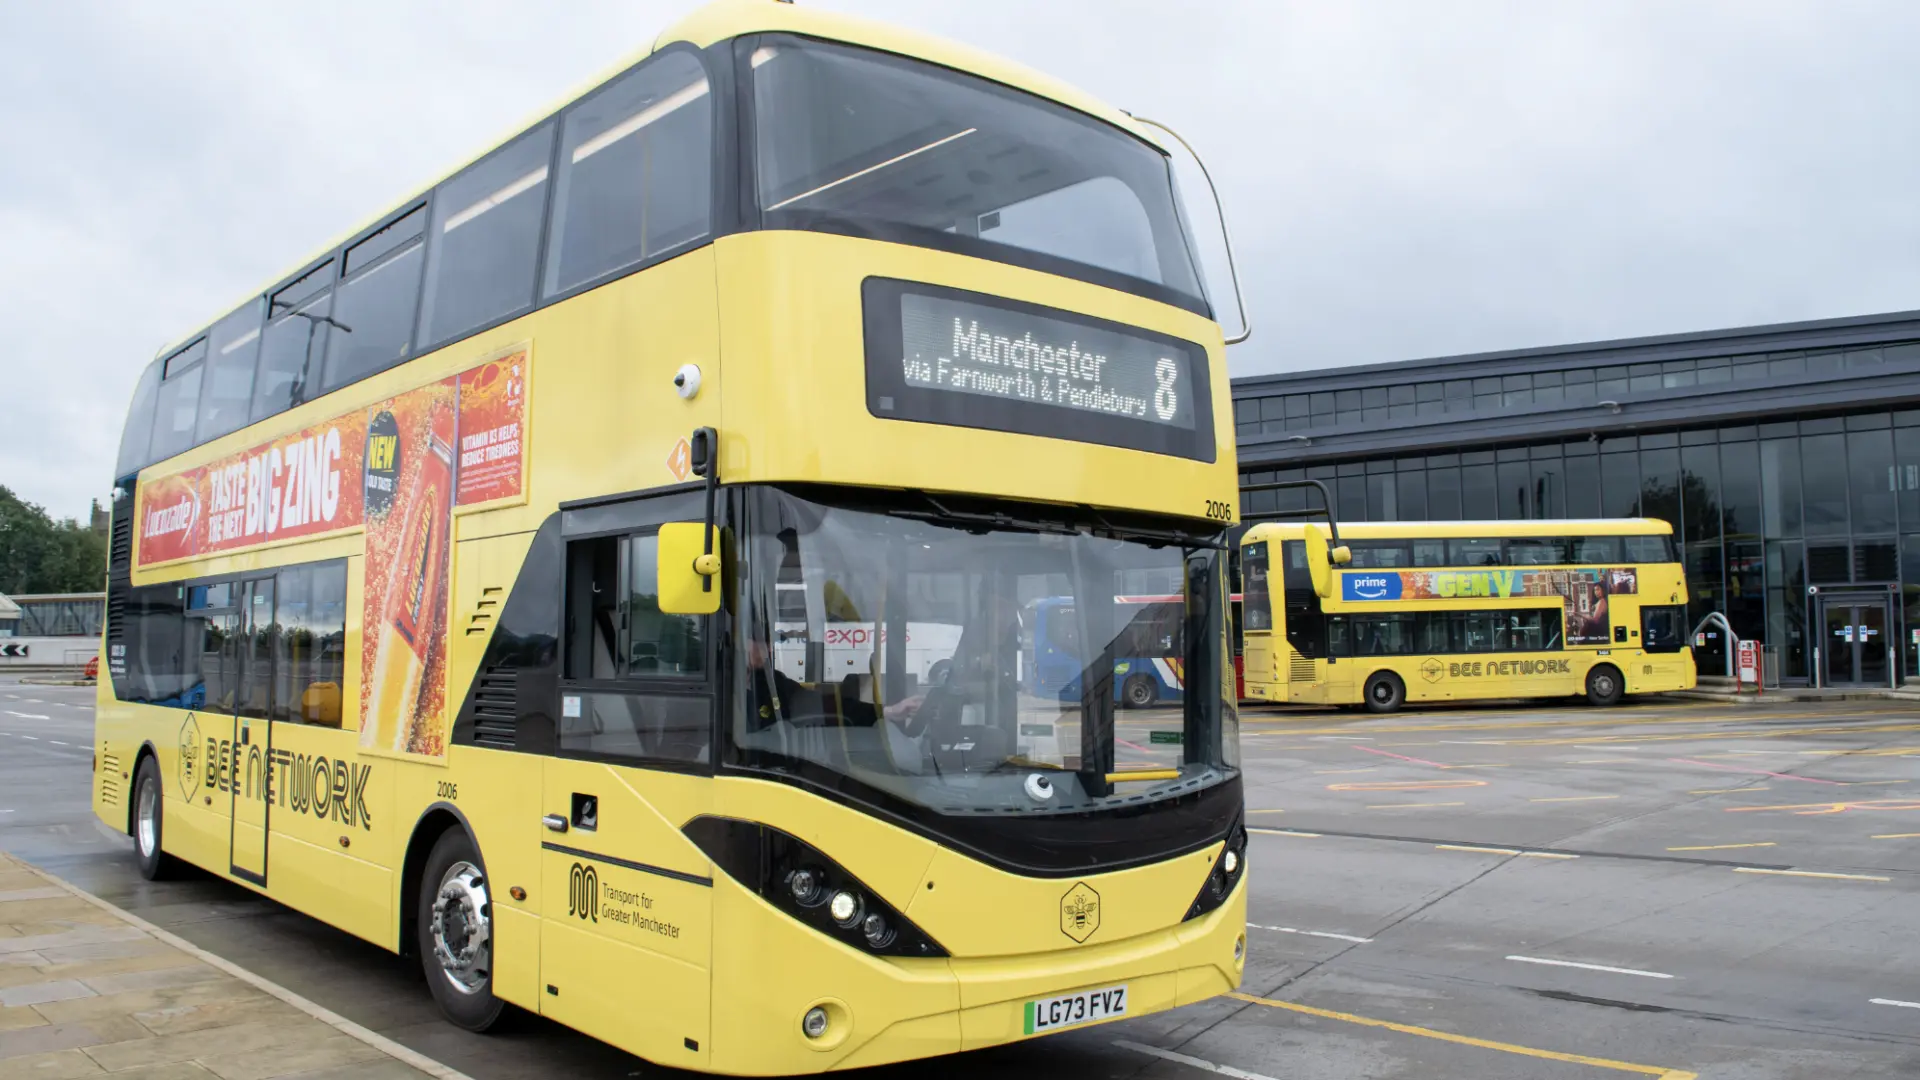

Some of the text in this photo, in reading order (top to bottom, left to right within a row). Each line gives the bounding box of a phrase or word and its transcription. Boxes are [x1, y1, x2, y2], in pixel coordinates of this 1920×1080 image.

[953, 317, 1107, 382] Manchester
[903, 353, 1147, 416] via Farnworth & Pendlebury
[1154, 357, 1177, 420] 8
[369, 434, 397, 469] NEW
[461, 439, 519, 468] REDUCE TIREDNESS
[462, 431, 488, 452] VITAMIN
[209, 461, 246, 514] TASTE
[245, 427, 341, 537] BIG ZING
[208, 508, 245, 543] THE NEXT
[1205, 499, 1232, 521] 2006
[1354, 577, 1387, 589] prime
[1437, 570, 1515, 598] GEN V
[1450, 659, 1571, 677] BEE NETWORK
[206, 737, 372, 832] BEE NETWORK
[437, 780, 458, 800] 2006
[602, 882, 654, 909] Transport for
[601, 903, 680, 939] Greater Manchester
[1037, 989, 1124, 1027] LG73 FVZ
